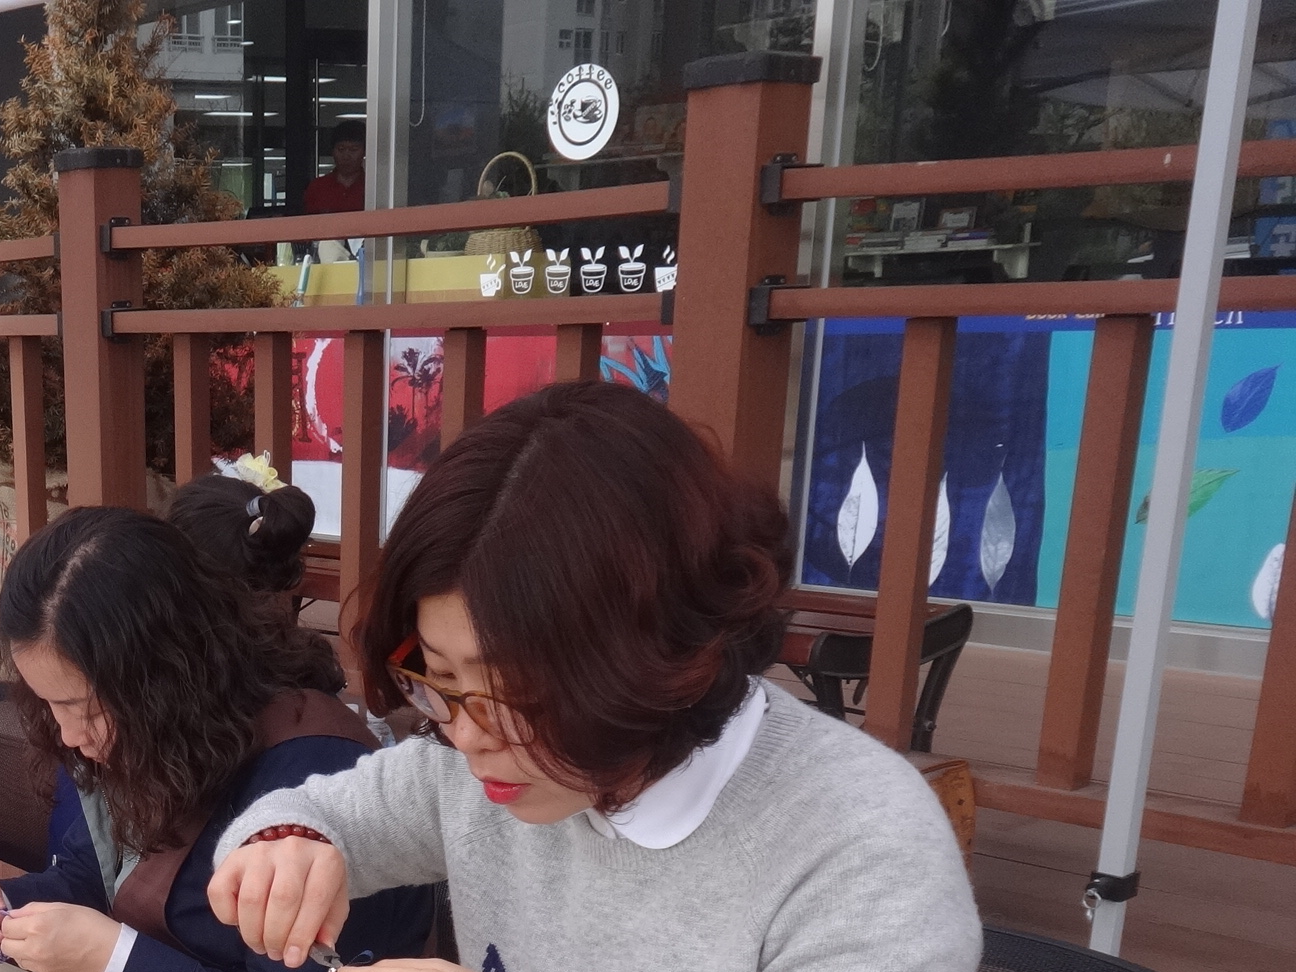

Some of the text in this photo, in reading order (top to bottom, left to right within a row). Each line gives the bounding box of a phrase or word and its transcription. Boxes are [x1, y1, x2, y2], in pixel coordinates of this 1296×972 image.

[558, 64, 612, 93] coffee
[515, 281, 529, 289] LOVE
[550, 280, 565, 288] LOVE
[586, 279, 600, 287] LOVE
[623, 278, 639, 287] LOVE
